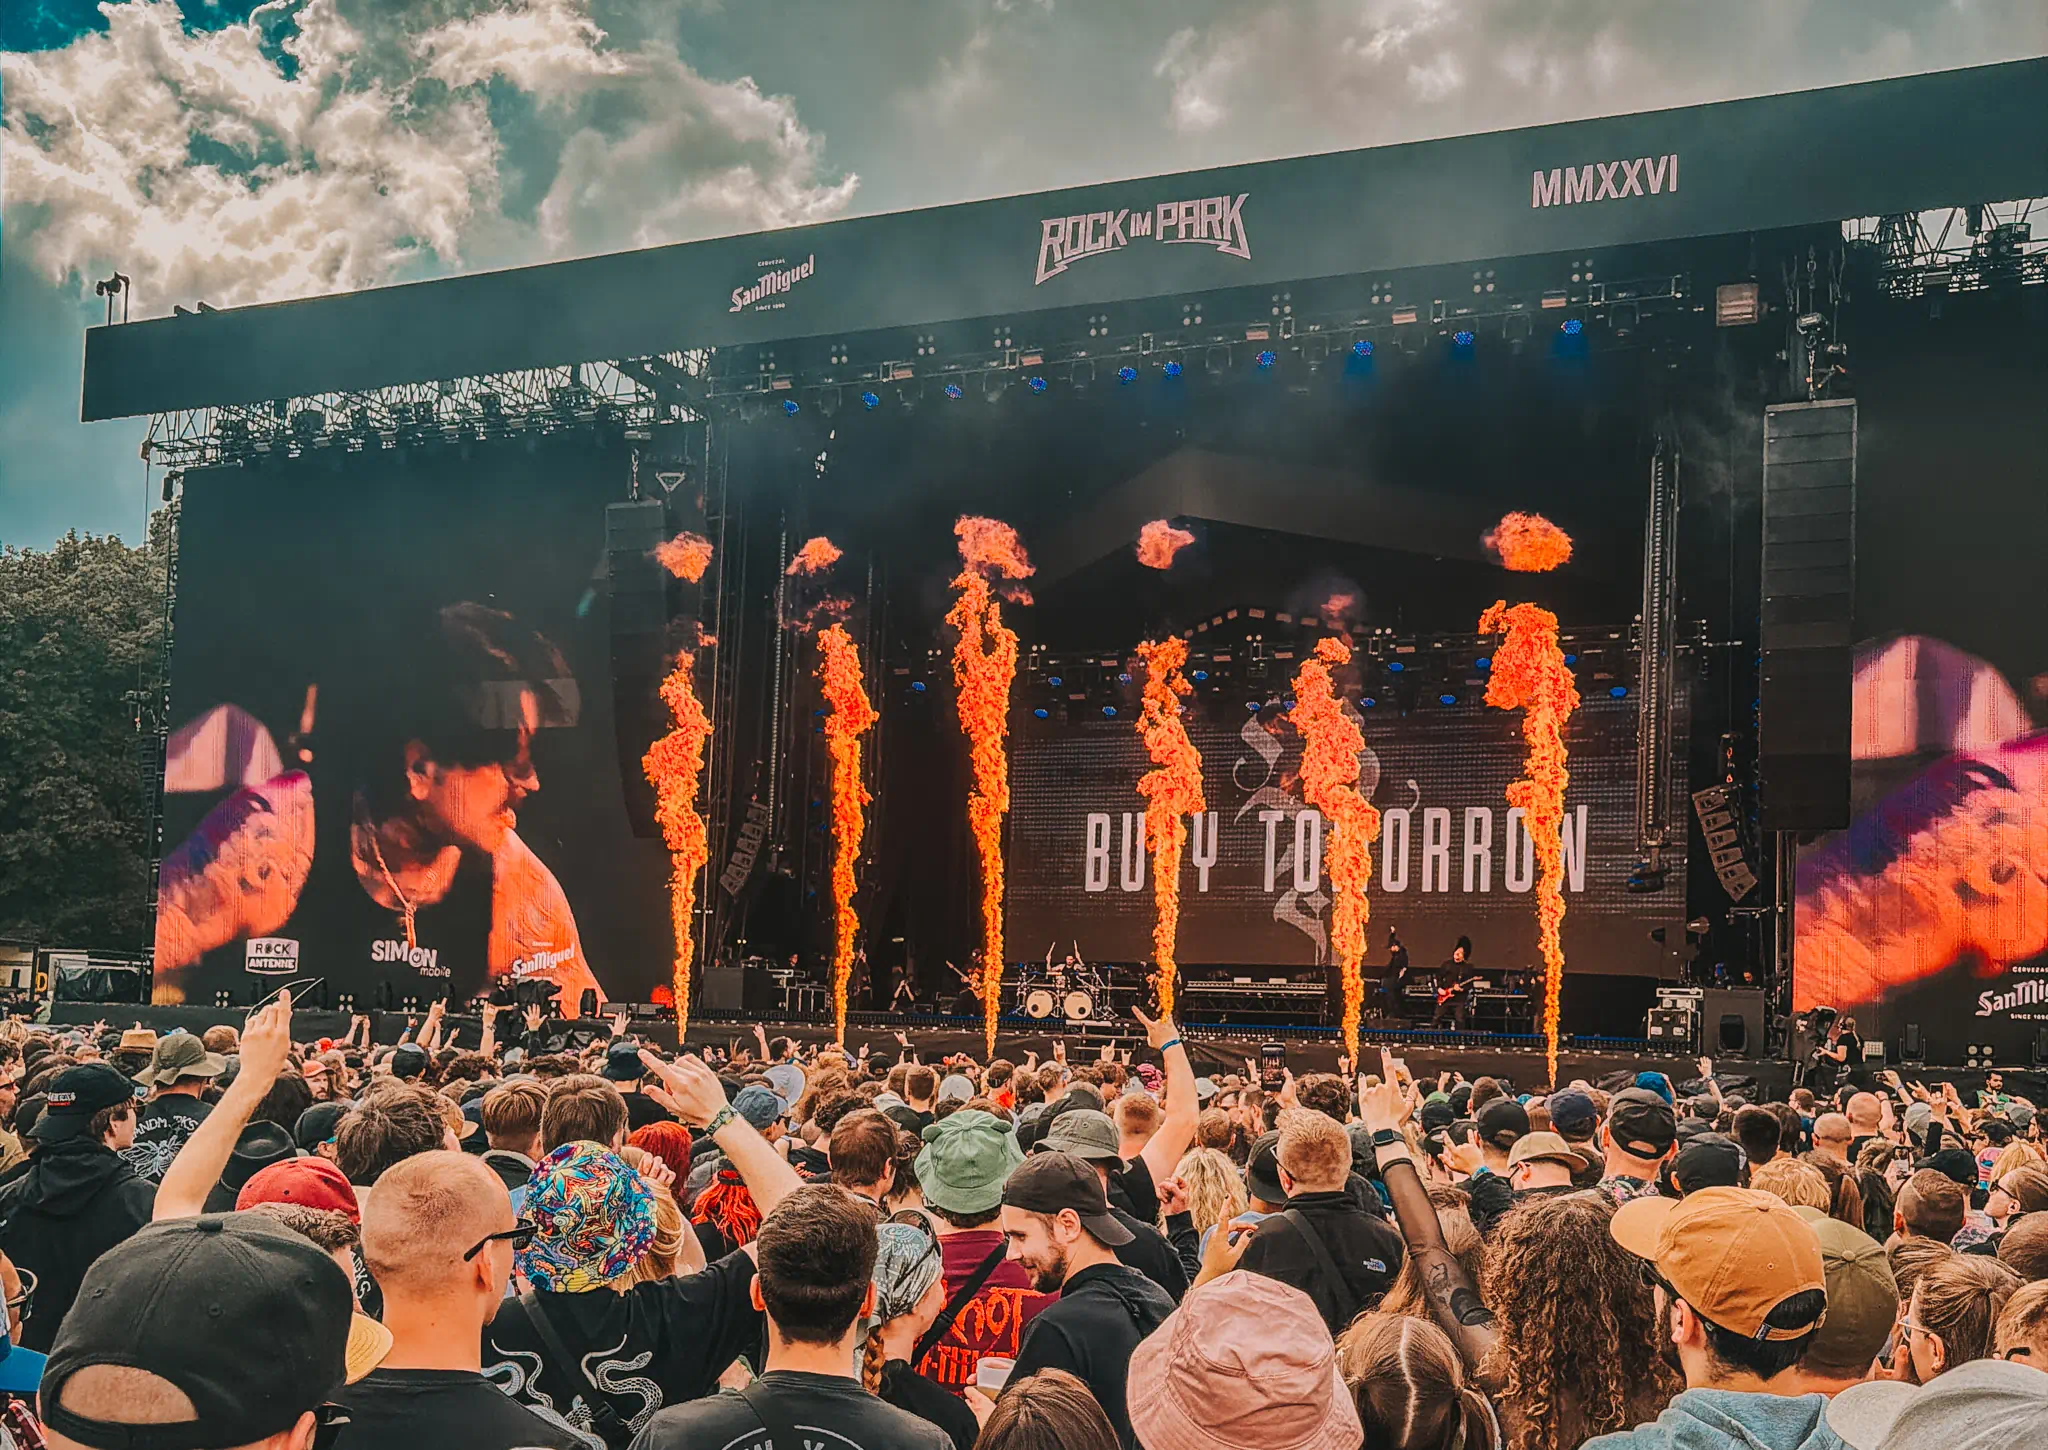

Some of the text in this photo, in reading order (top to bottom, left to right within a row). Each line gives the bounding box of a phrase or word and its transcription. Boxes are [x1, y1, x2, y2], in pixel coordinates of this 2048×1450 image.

[1532, 154, 1678, 208] MMXXVI
[1035, 193, 1251, 285] ROCK IM PARK
[1085, 804, 1588, 893] BUY TOORROW
[249, 958, 295, 969] ANTENNE
[371, 940, 437, 968] SIMON
[420, 966, 451, 977] mobile
